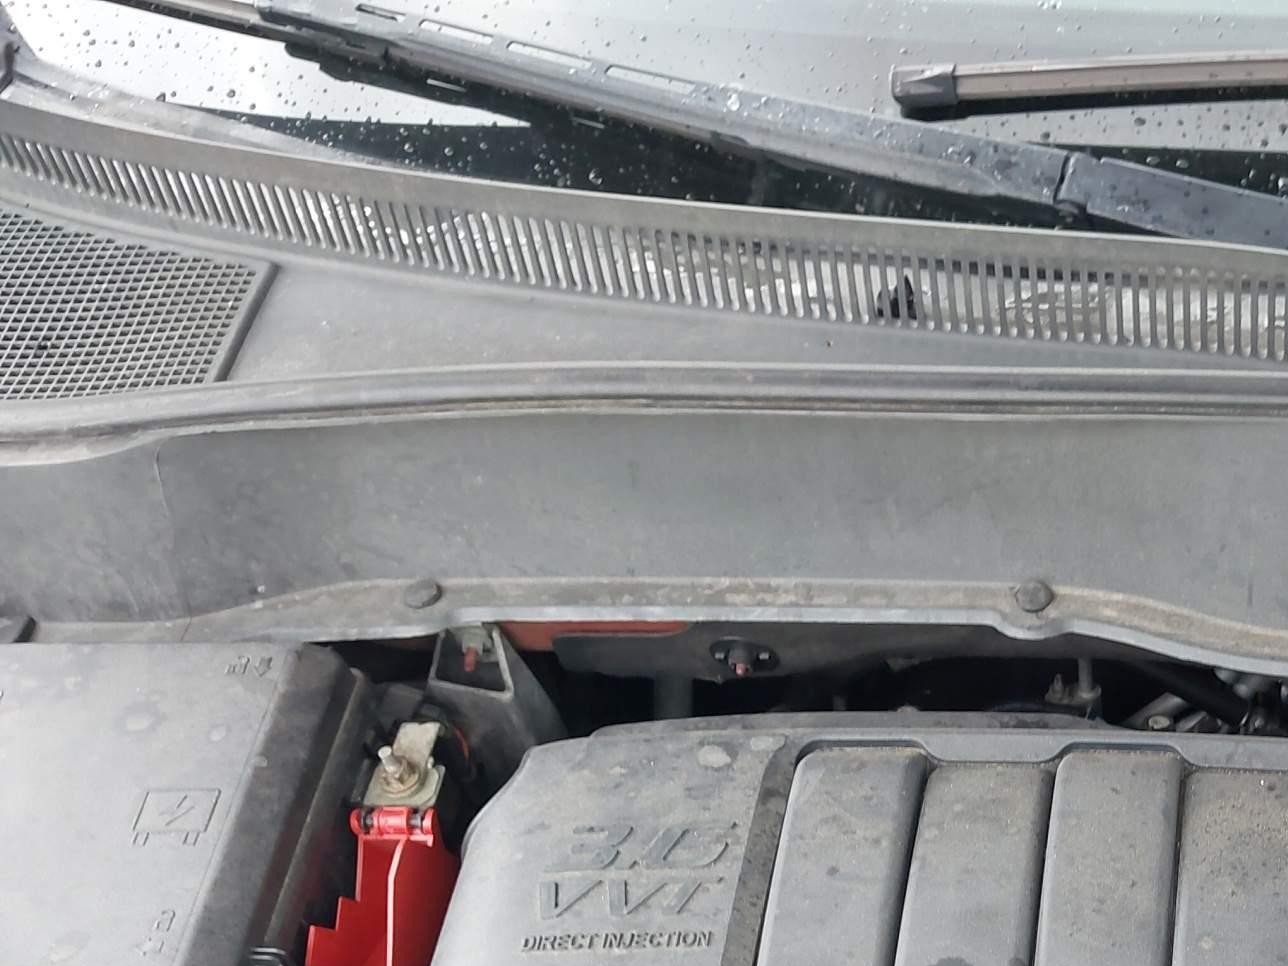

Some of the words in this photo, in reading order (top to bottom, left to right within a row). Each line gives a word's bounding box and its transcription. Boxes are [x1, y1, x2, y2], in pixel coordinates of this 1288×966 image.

[538, 876, 726, 920] VVT
[521, 932, 601, 953] DIRECT
[602, 930, 713, 951] INJECTION
